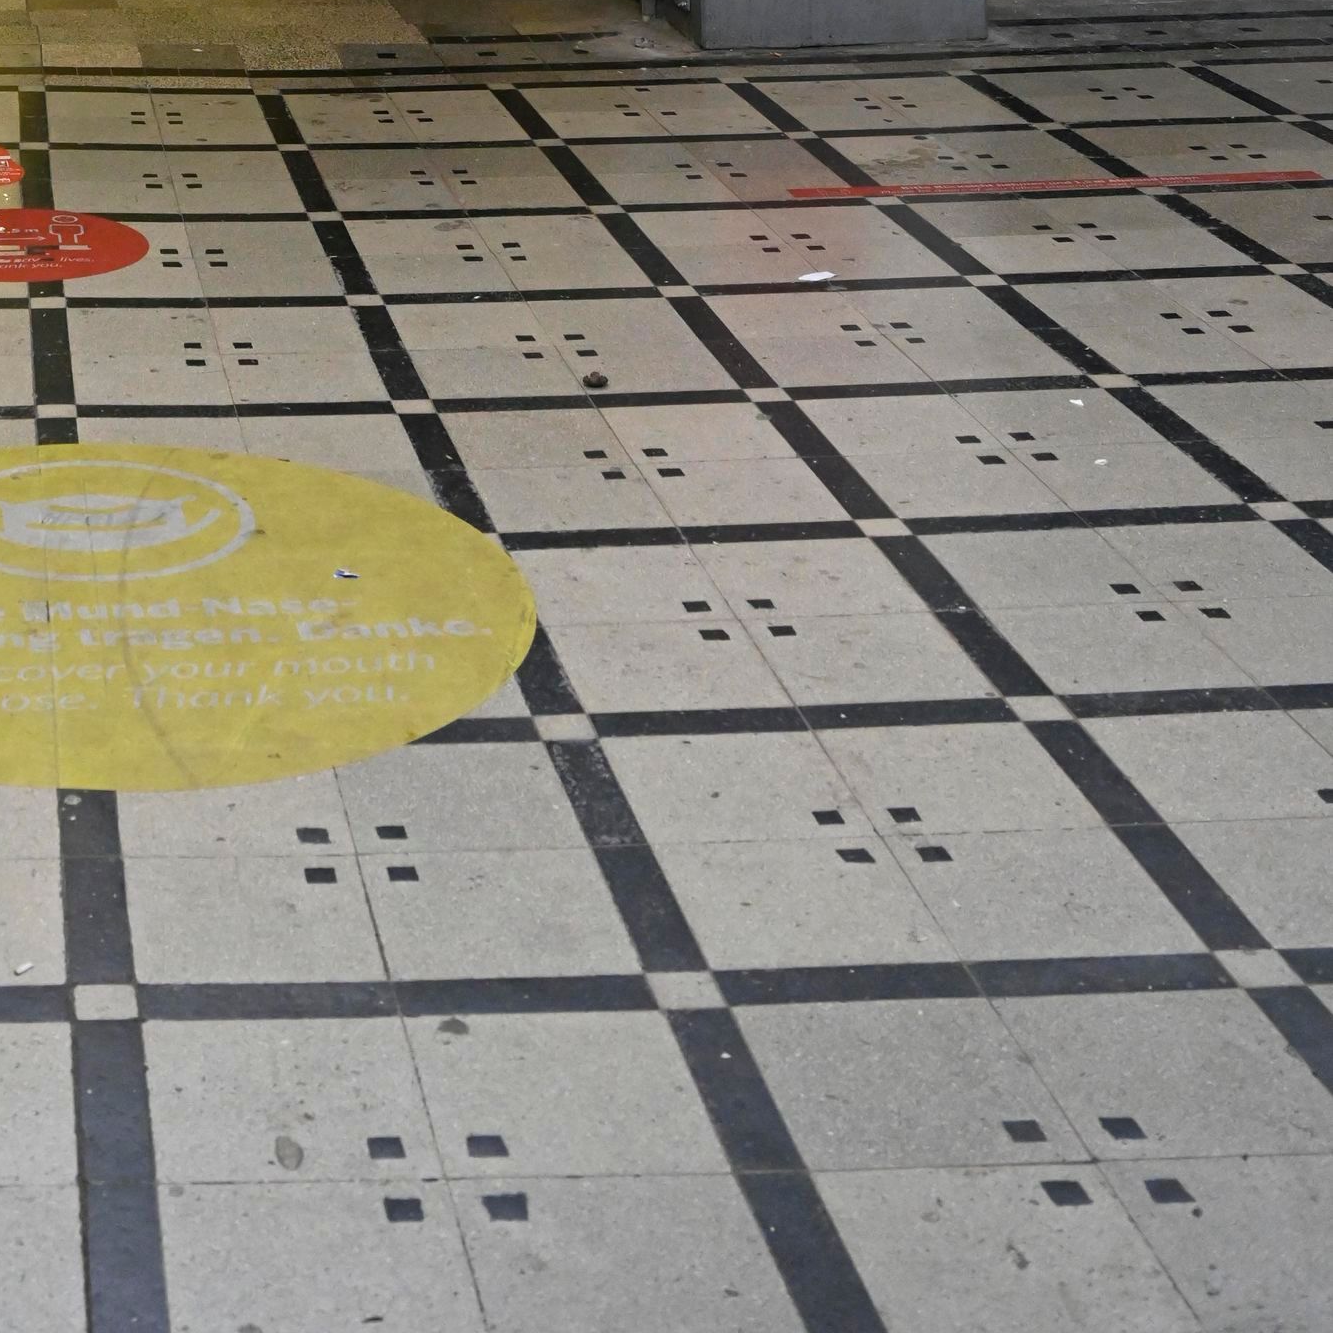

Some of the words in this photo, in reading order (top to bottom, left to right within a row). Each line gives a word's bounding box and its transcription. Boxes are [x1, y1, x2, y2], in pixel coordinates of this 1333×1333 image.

[21, 597, 359, 623] Mund-Nase-
[79, 626, 278, 650] tragen.
[296, 617, 493, 642] Danke.
[142, 658, 254, 686] your
[273, 650, 436, 678] mouth
[129, 682, 284, 710] Thank
[303, 683, 412, 711] you.
